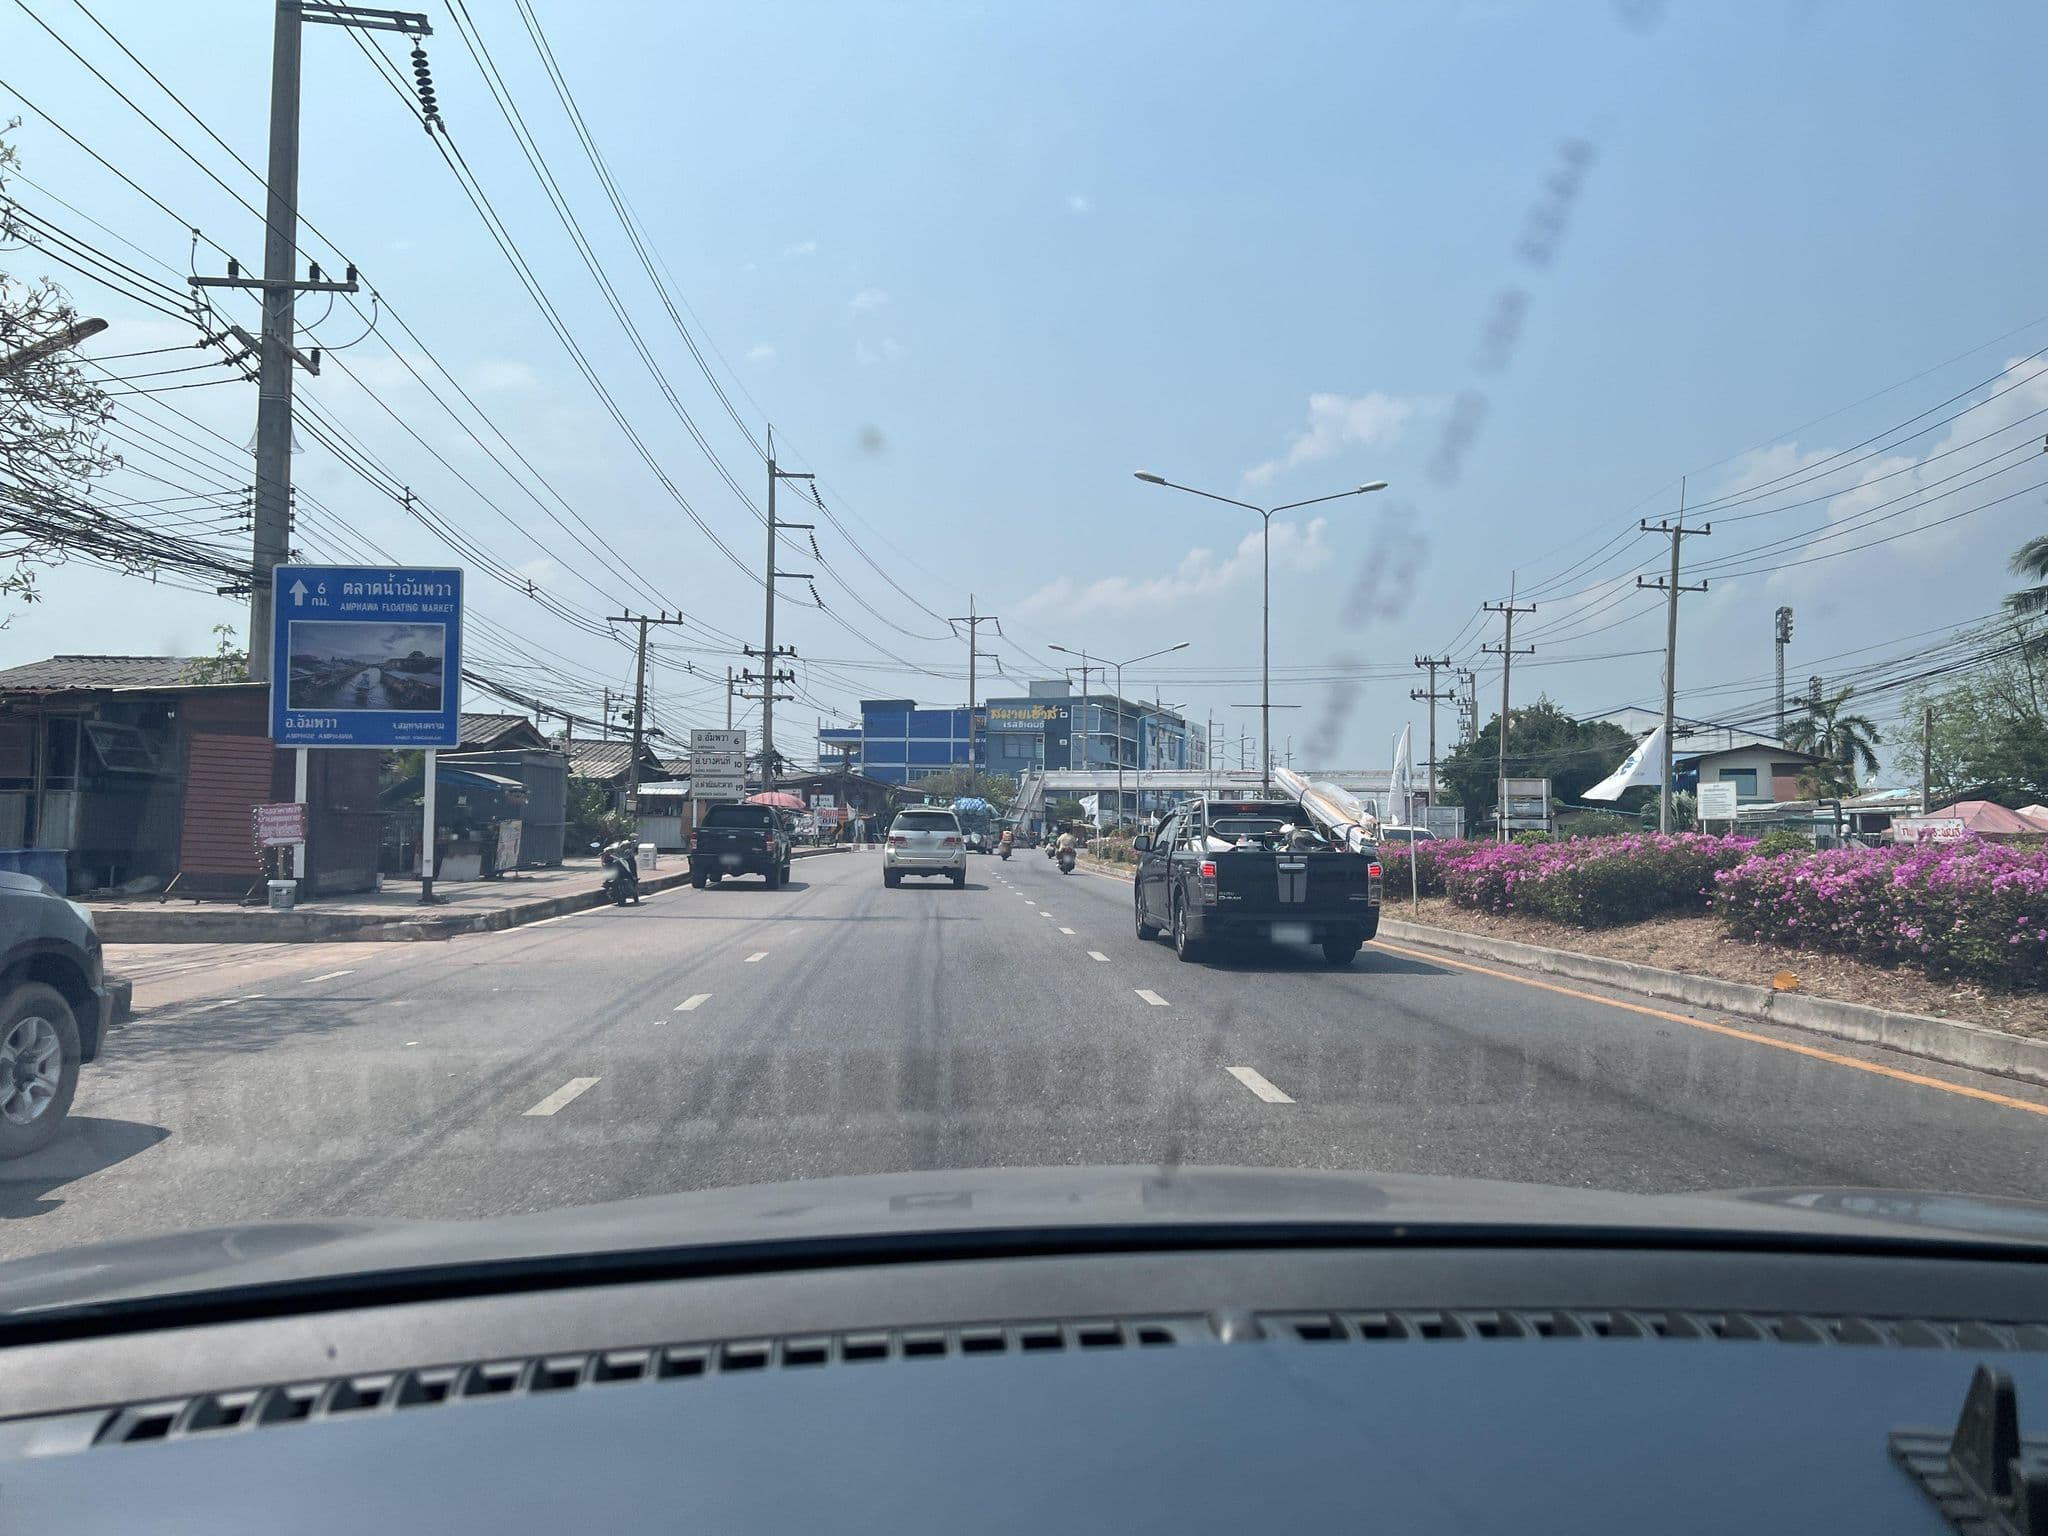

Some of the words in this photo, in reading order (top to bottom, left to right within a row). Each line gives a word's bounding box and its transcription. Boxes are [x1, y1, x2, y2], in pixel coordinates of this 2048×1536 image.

[317, 582, 326, 595] 6
[343, 573, 451, 596] ตลาดน้ำอัมพวา
[311, 597, 330, 607] กม.
[340, 602, 379, 612] AMPHAWA
[382, 603, 418, 612] FLOATING
[422, 604, 454, 613] MARKET
[286, 715, 337, 729] อ.อัมพวา
